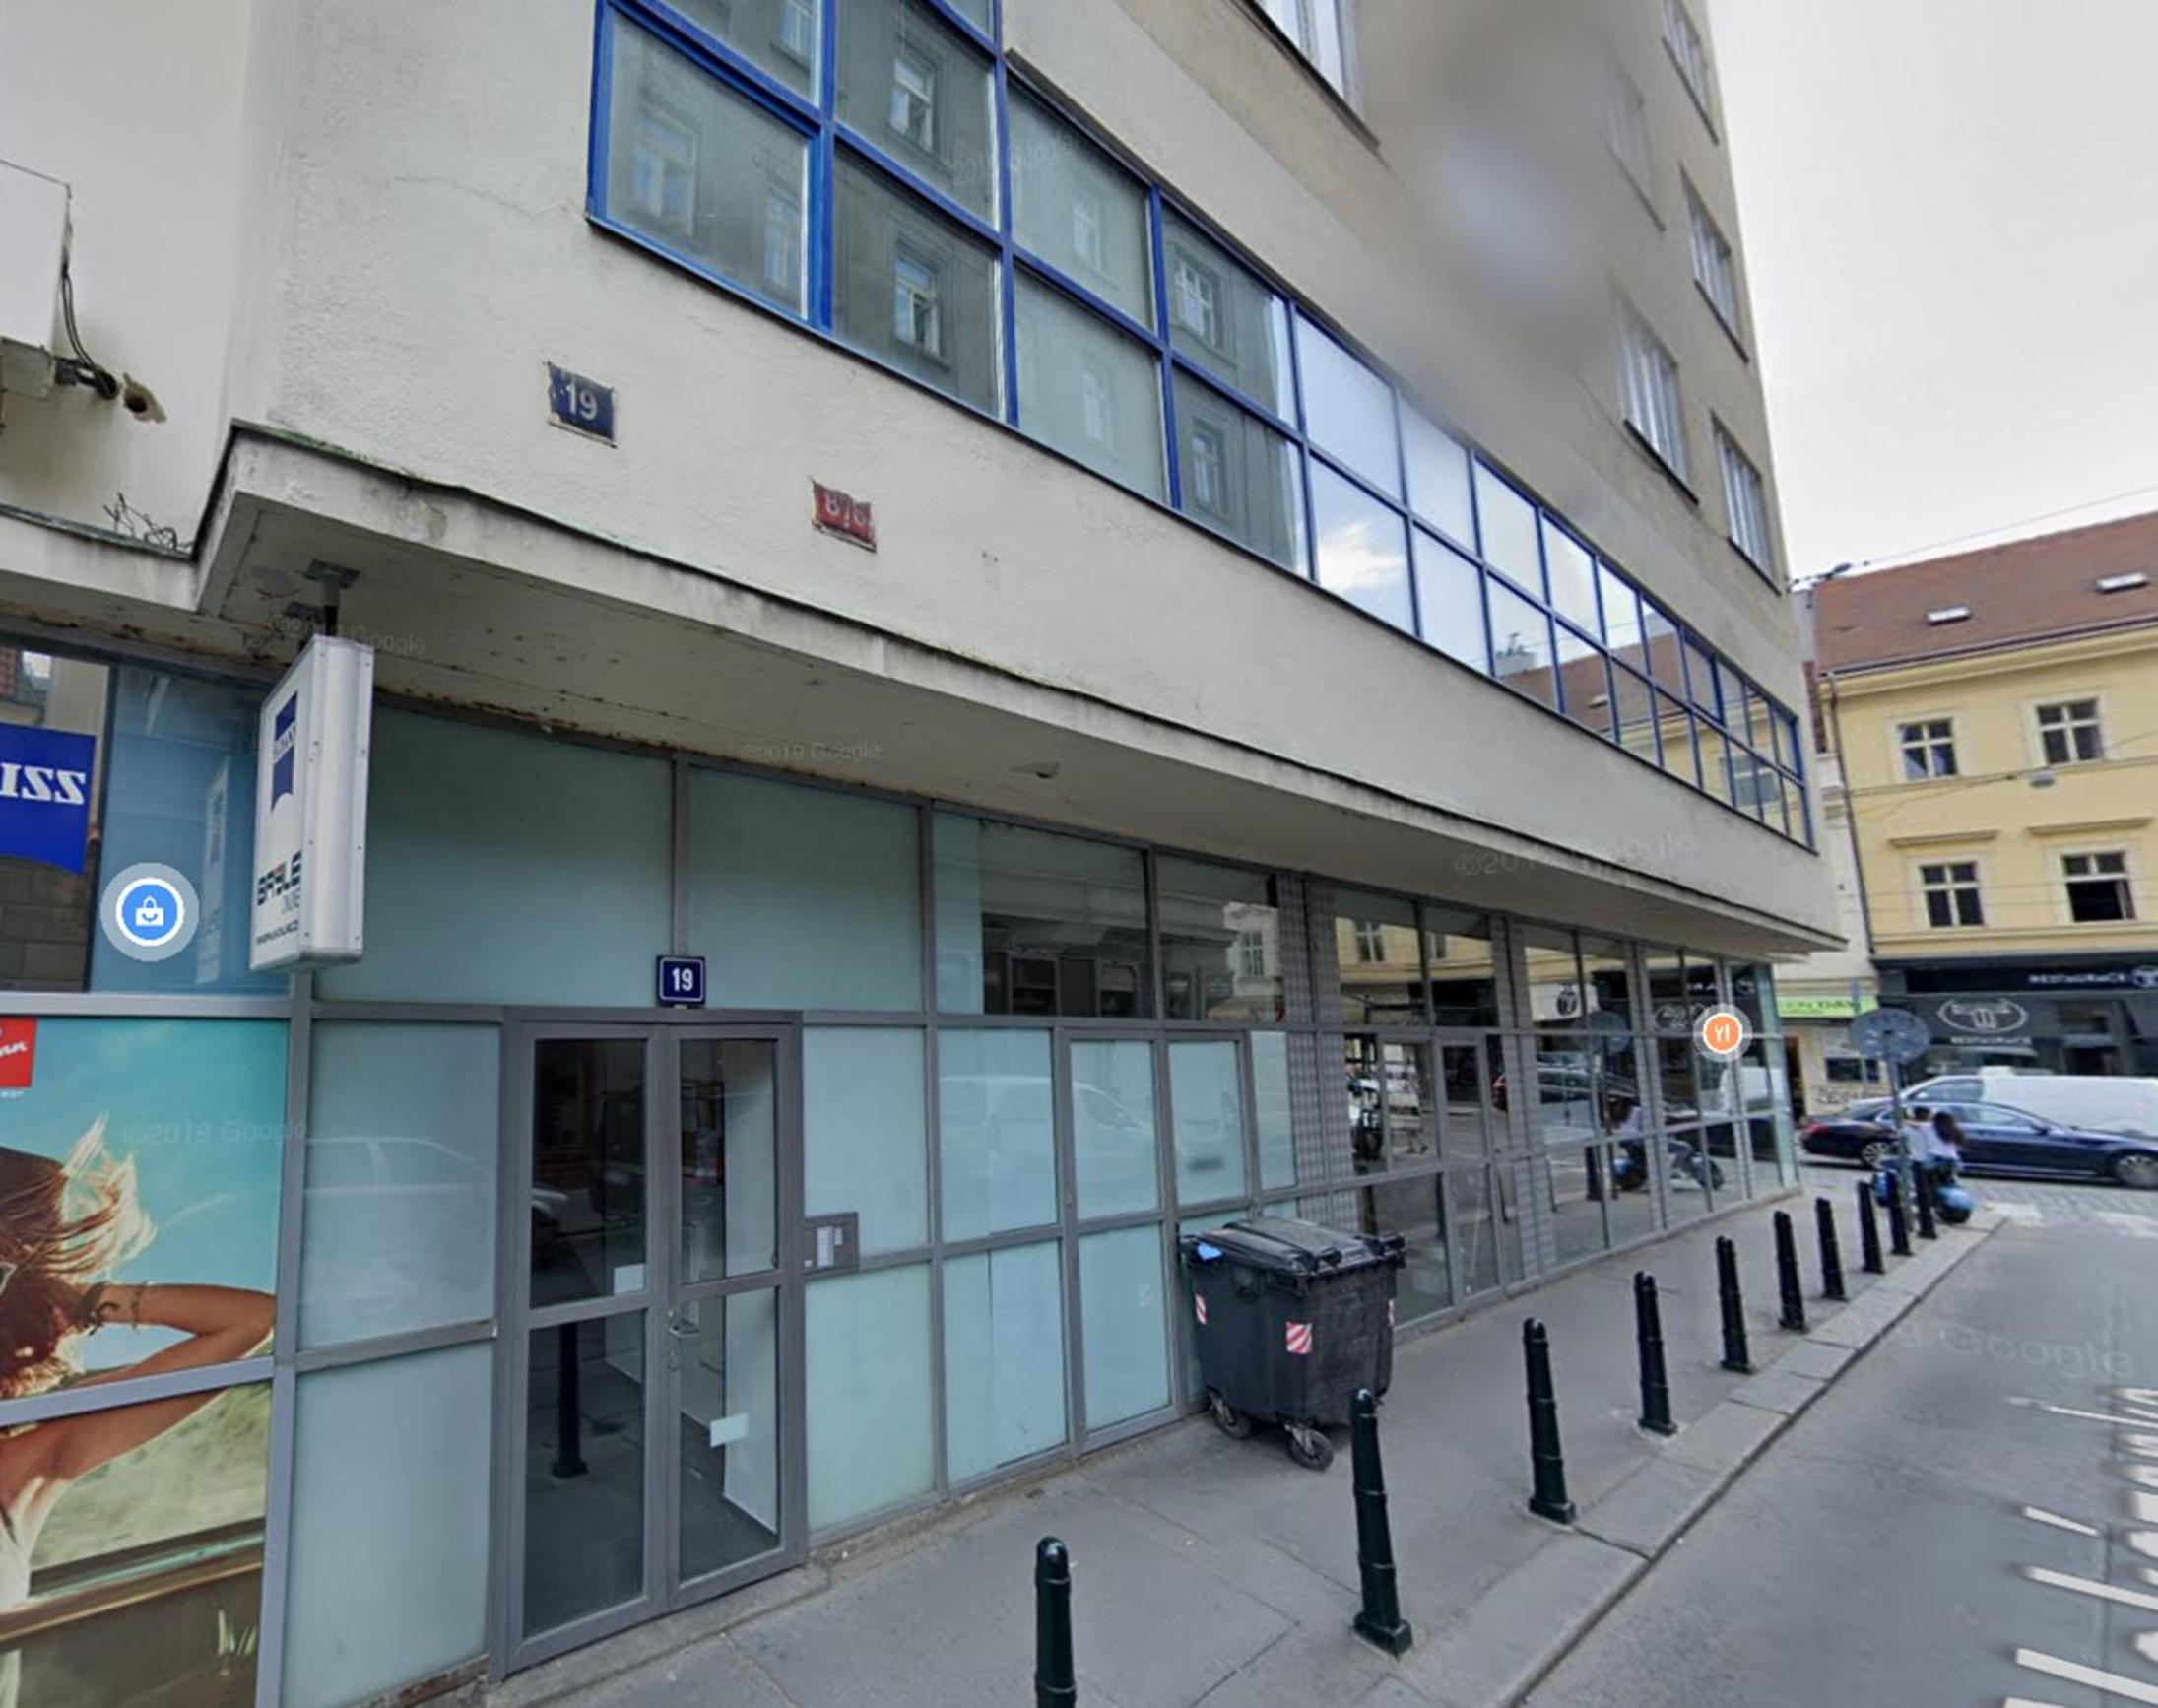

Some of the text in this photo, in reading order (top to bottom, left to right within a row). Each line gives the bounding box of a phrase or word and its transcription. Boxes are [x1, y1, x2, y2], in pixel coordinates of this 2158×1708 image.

[566, 378, 598, 421] 19
[0, 762, 86, 806] ISS
[672, 967, 694, 992] 19
